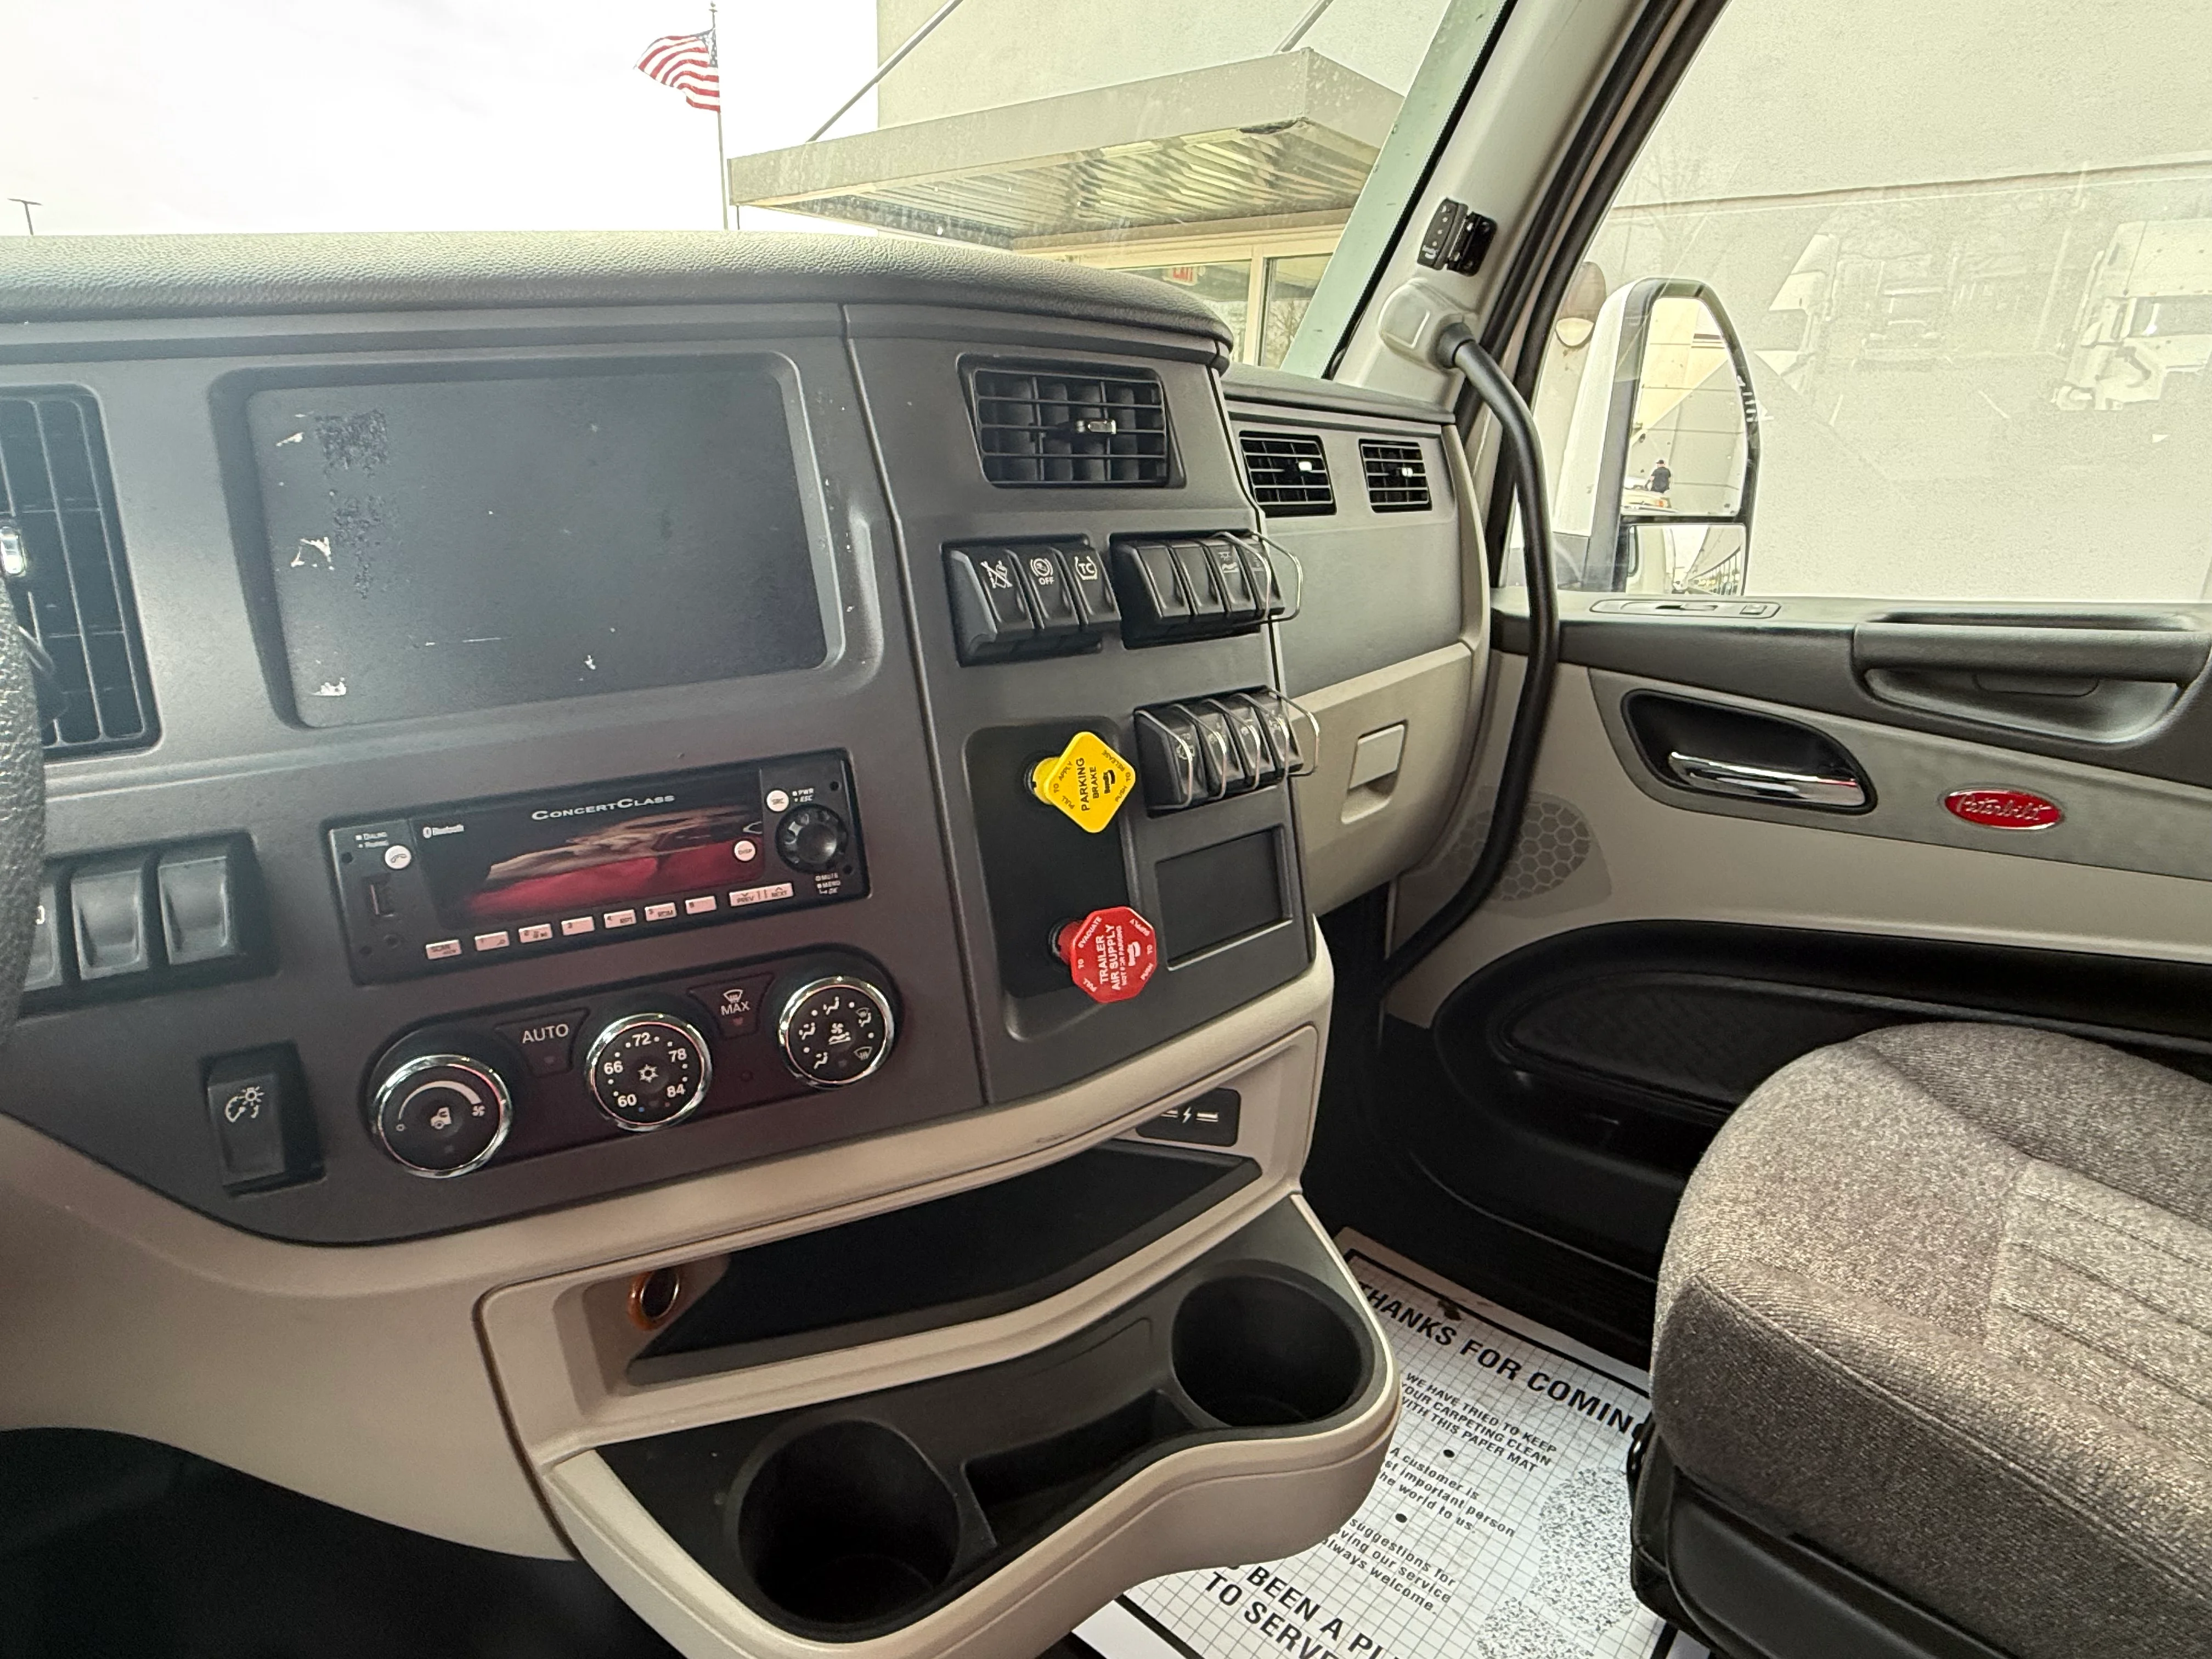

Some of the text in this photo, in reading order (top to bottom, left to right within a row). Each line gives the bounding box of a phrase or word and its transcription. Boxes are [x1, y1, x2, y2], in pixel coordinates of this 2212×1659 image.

[1078, 563, 1095, 574] TC
[1053, 783, 1059, 794] TO
[1058, 761, 1073, 781] APPLY
[1076, 757, 1091, 812] PARKING
[1090, 766, 1100, 799] BRAKE
[1102, 750, 1131, 802] PUSH TO RELEASE
[1095, 935, 1109, 984] TRAILER
[1105, 924, 1121, 990] AIR SUPPLY
[1147, 944, 1153, 955] TO
[721, 1001, 751, 1015] MAX
[522, 1024, 569, 1043] AUTO
[632, 1032, 652, 1046] 72
[668, 1048, 687, 1062] 78
[604, 1060, 623, 1075] 66
[667, 1084, 686, 1098] 84
[618, 1094, 637, 1108] 60
[1459, 1339, 1521, 1380] FOR
[1407, 1373, 1557, 1453] WE HAVE TRIED TO KEEP
[1433, 1401, 1505, 1442] CARPETING
[1506, 1438, 1552, 1466] CLEAN
[1431, 1413, 1460, 1435] THIS
[1462, 1430, 1504, 1457] PAPER
[1507, 1452, 1538, 1473] MAT
[1390, 1447, 1479, 1500] A customer is
[1379, 1471, 1476, 1534] he world to us.
[1400, 1468, 1465, 1509] important
[1465, 1505, 1515, 1537] person
[1340, 1530, 1452, 1603] ving our service
[1350, 1518, 1457, 1587] suggestions for
[1205, 1571, 1243, 1606] TO
[1246, 1566, 1344, 1641] BEEN A
[1371, 1566, 1437, 1615] welcome.
